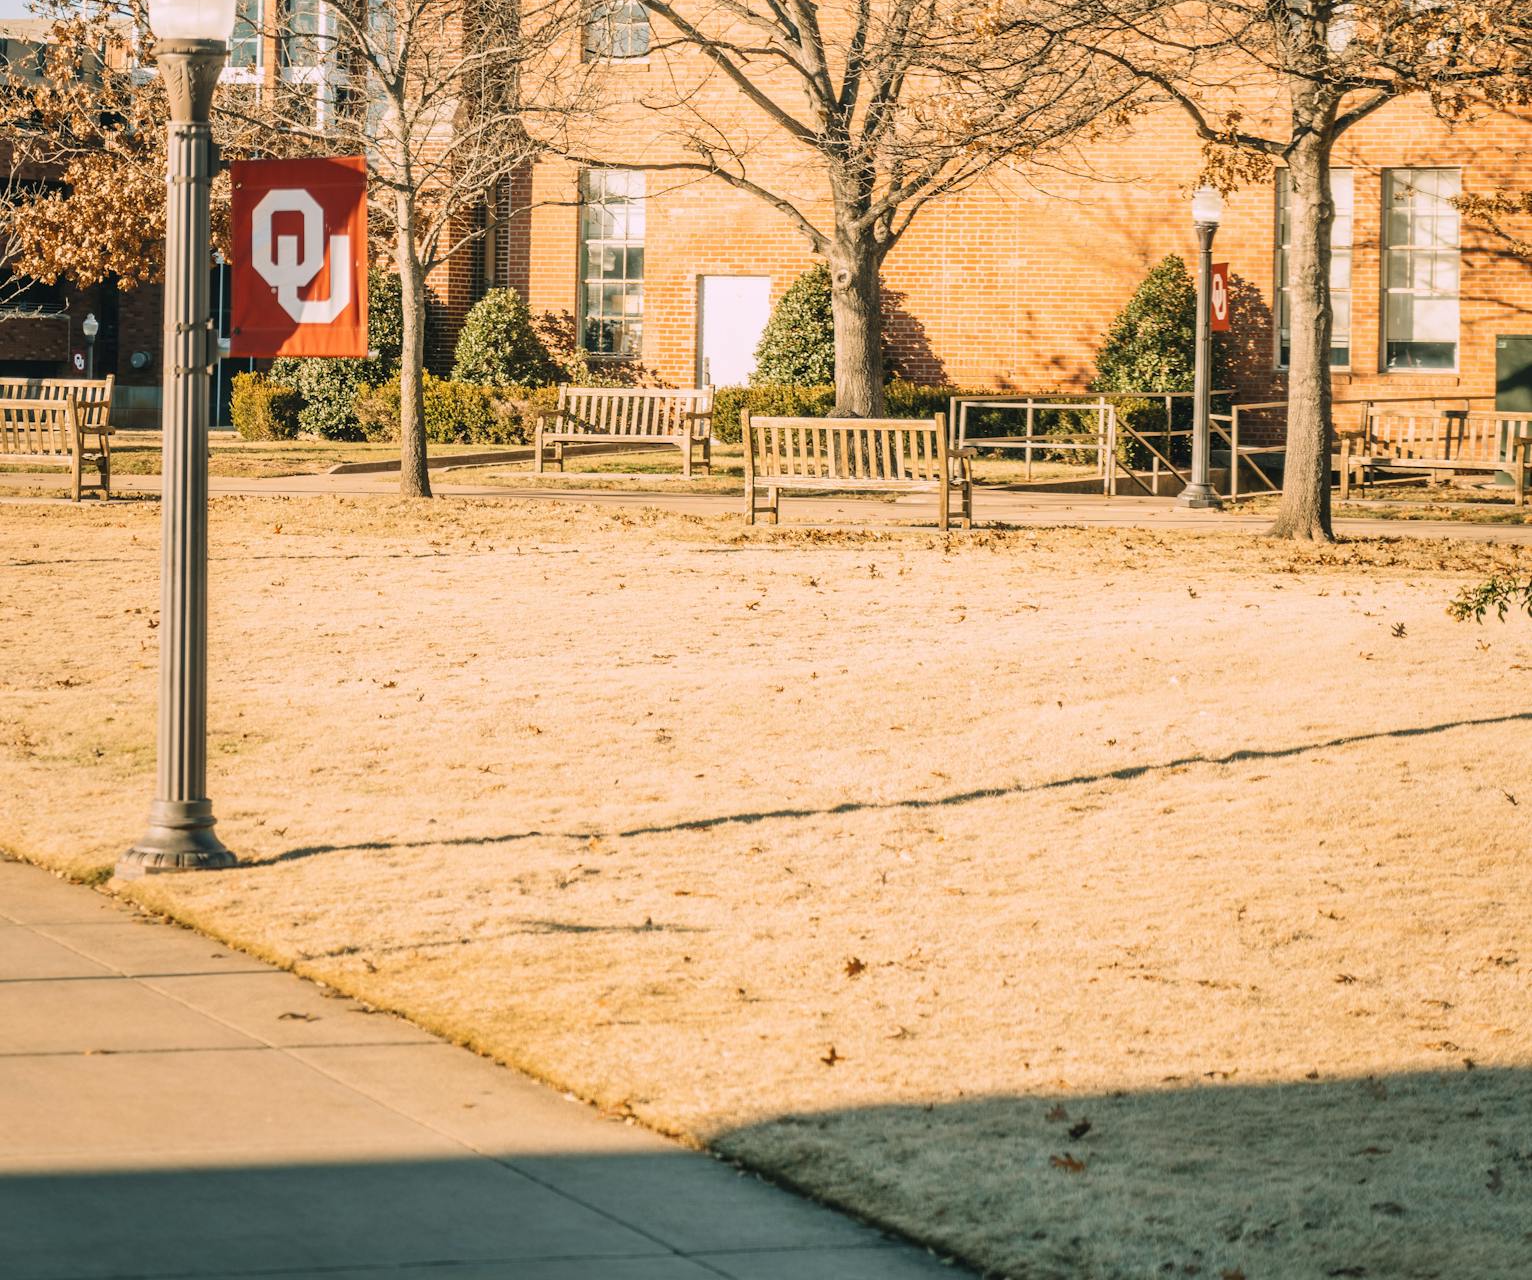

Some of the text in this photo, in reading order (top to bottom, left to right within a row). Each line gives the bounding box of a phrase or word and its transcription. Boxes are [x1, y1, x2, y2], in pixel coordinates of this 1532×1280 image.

[252, 189, 350, 323] OU
[1212, 273, 1226, 320] OU
[74, 353, 84, 370] OU
